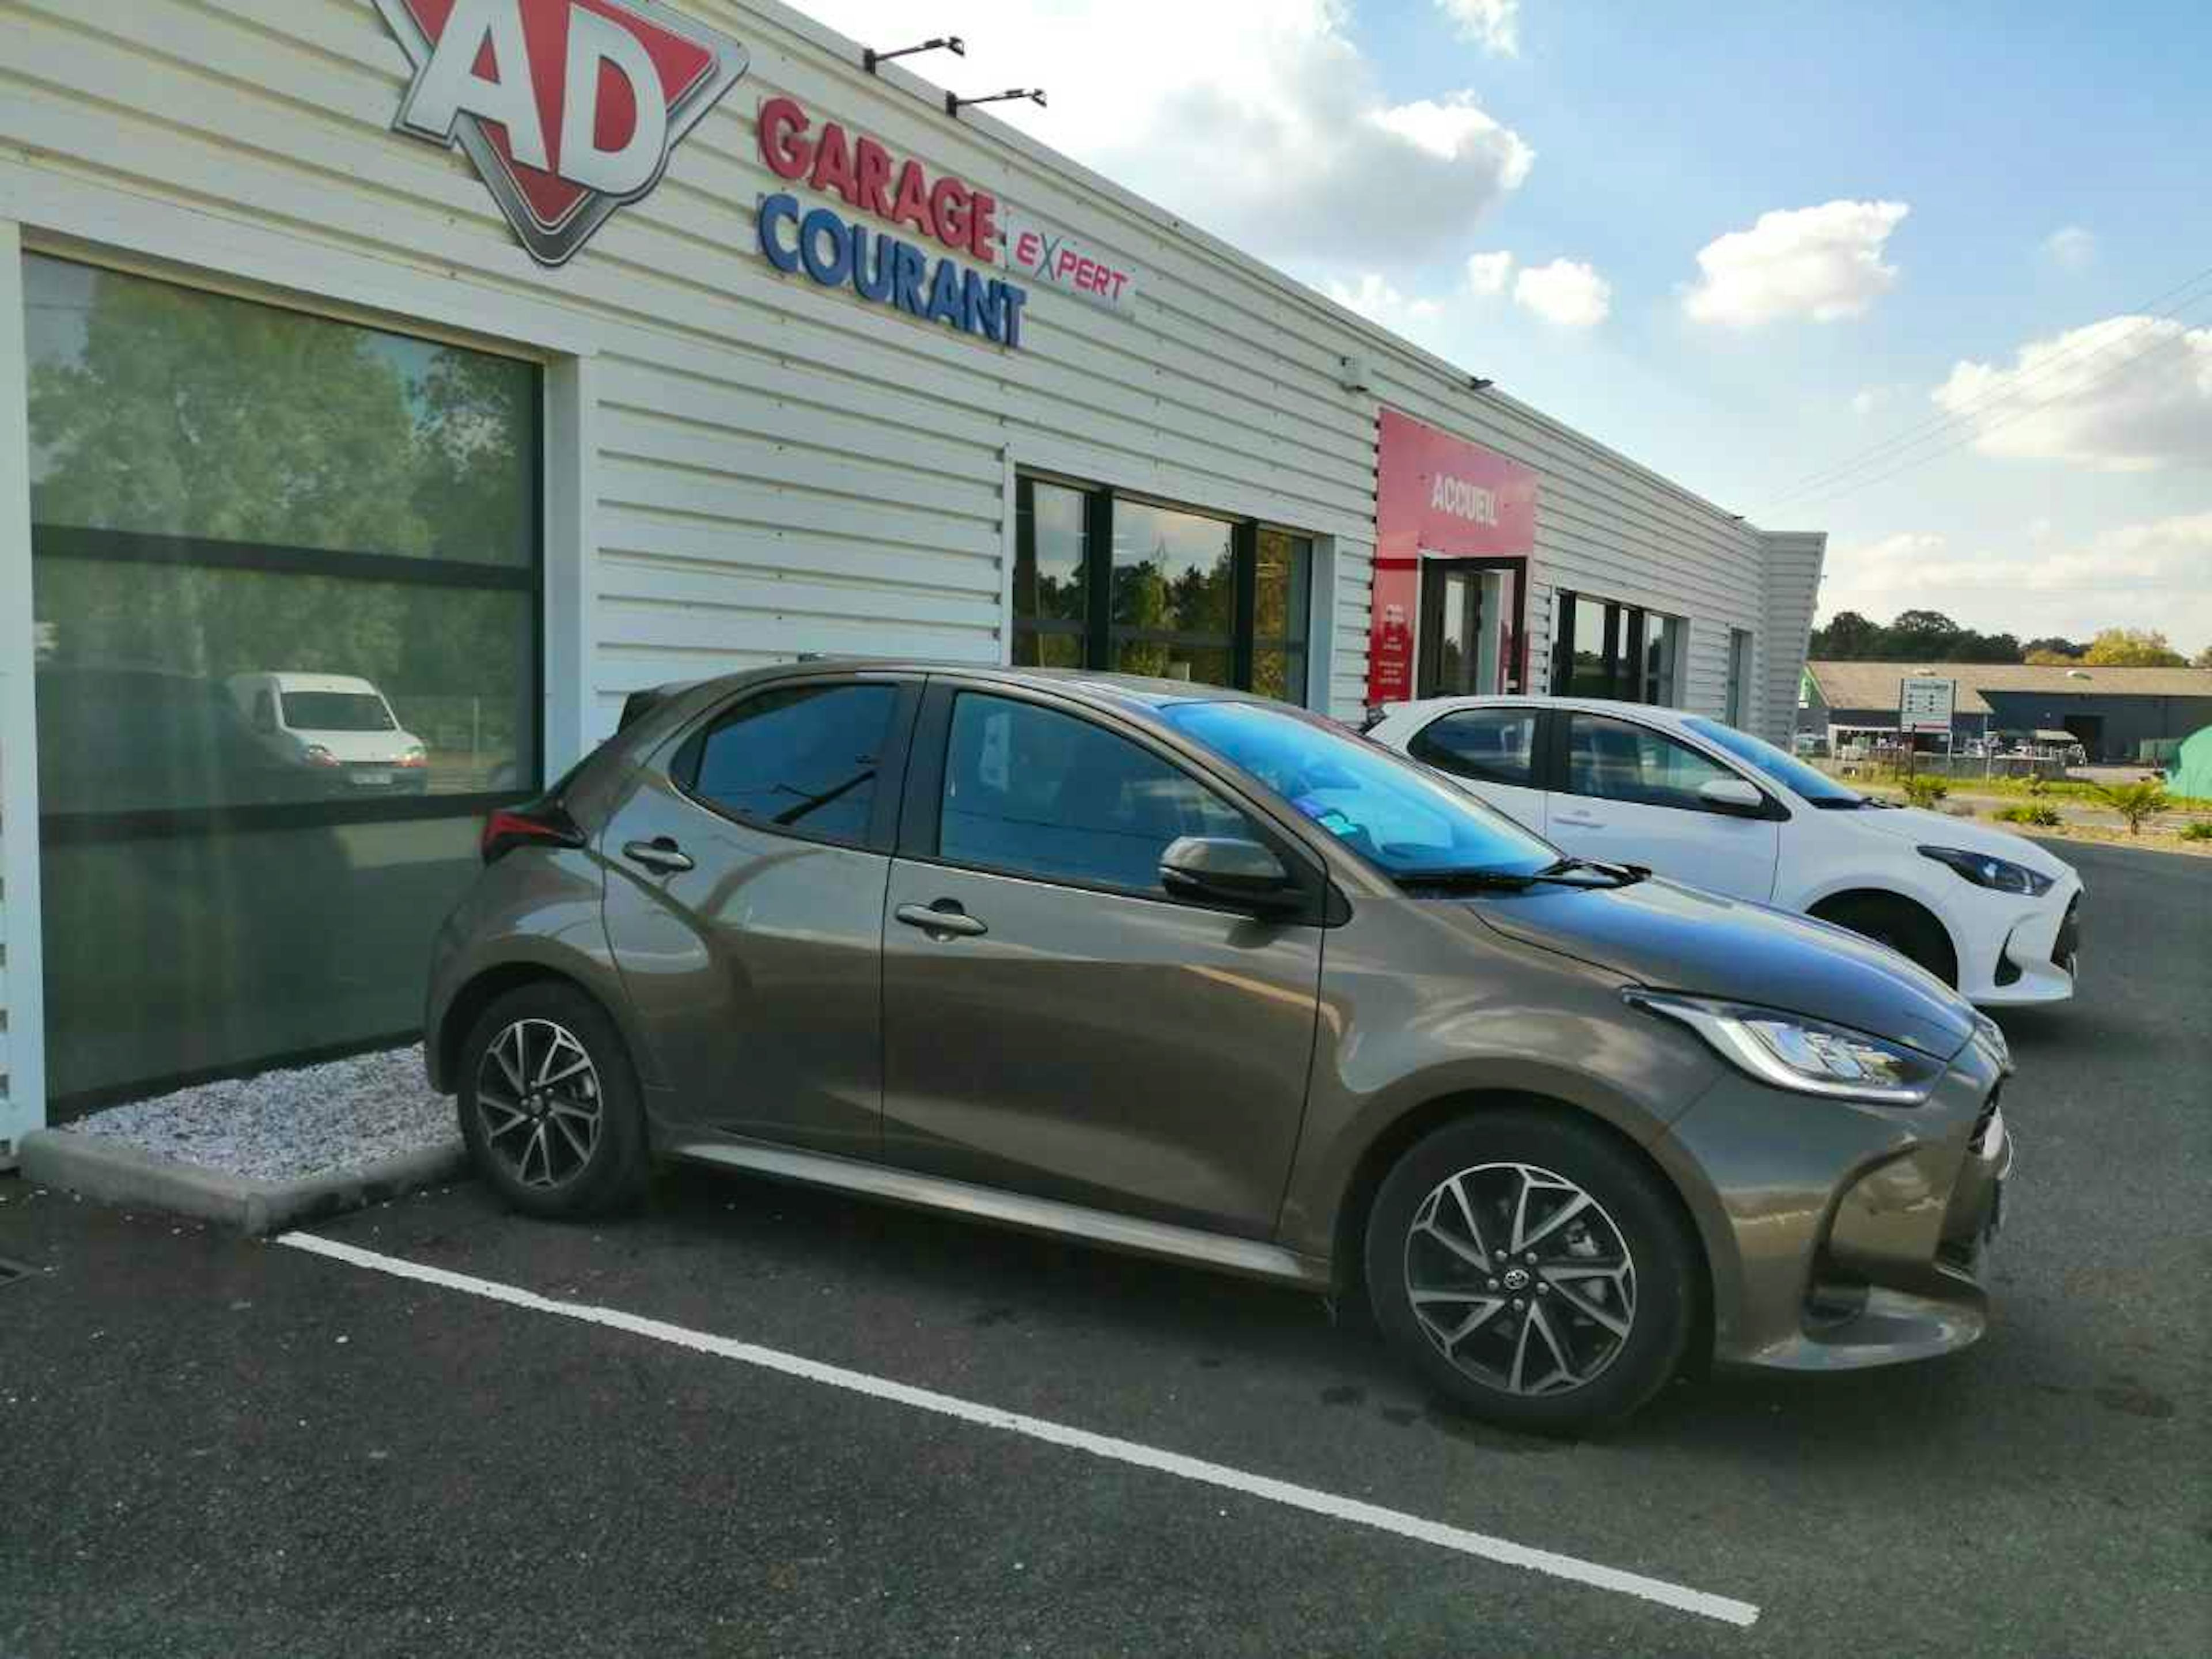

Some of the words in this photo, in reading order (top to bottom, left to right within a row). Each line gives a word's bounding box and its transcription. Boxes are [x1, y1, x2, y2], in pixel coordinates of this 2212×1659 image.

[402, 0, 667, 197] AD
[759, 97, 997, 264] GARAGE
[759, 193, 1026, 347] COURANT
[1016, 232, 1128, 301] EXPERT
[1431, 472, 1499, 527] ACCUEIL
